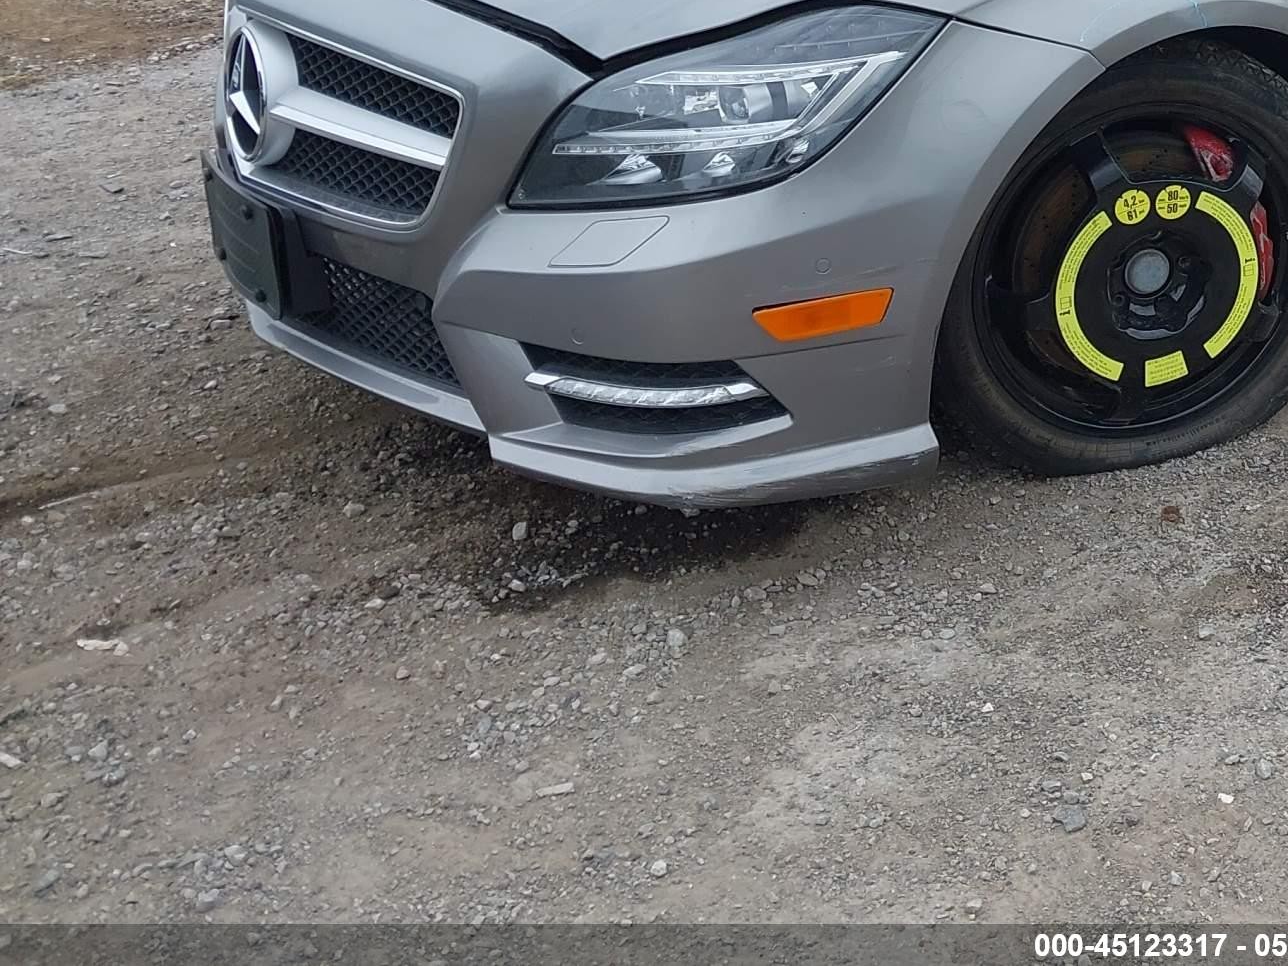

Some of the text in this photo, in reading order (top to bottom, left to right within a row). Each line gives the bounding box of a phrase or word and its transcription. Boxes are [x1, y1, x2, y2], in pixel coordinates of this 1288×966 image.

[1167, 190, 1179, 201] 80
[1123, 195, 1138, 210] 4,2
[1167, 203, 1178, 214] 50
[1126, 209, 1138, 221] 61
